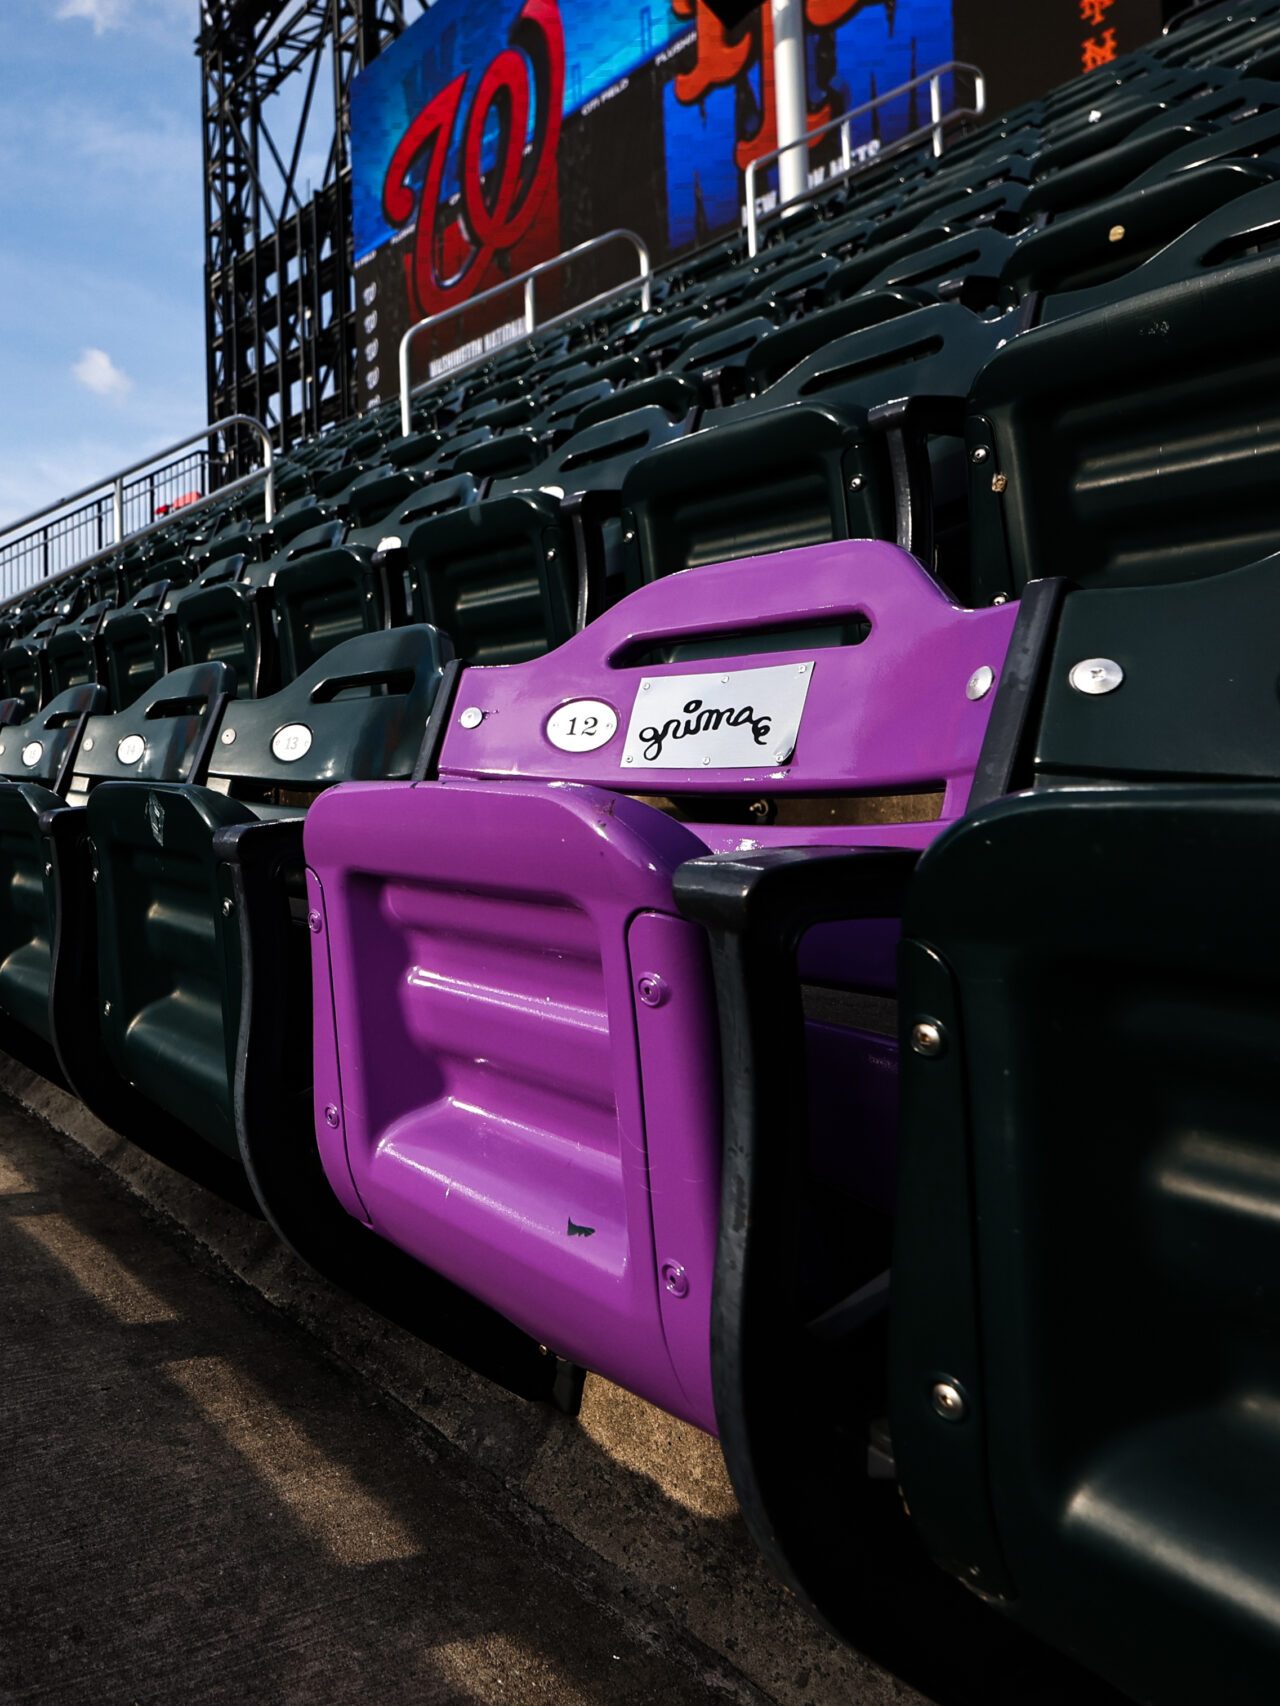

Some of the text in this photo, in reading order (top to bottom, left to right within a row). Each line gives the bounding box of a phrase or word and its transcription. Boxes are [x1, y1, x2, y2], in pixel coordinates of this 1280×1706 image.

[484, 315, 526, 353] NATIONAL
[566, 716, 599, 736] 12
[284, 736, 299, 750] 13
